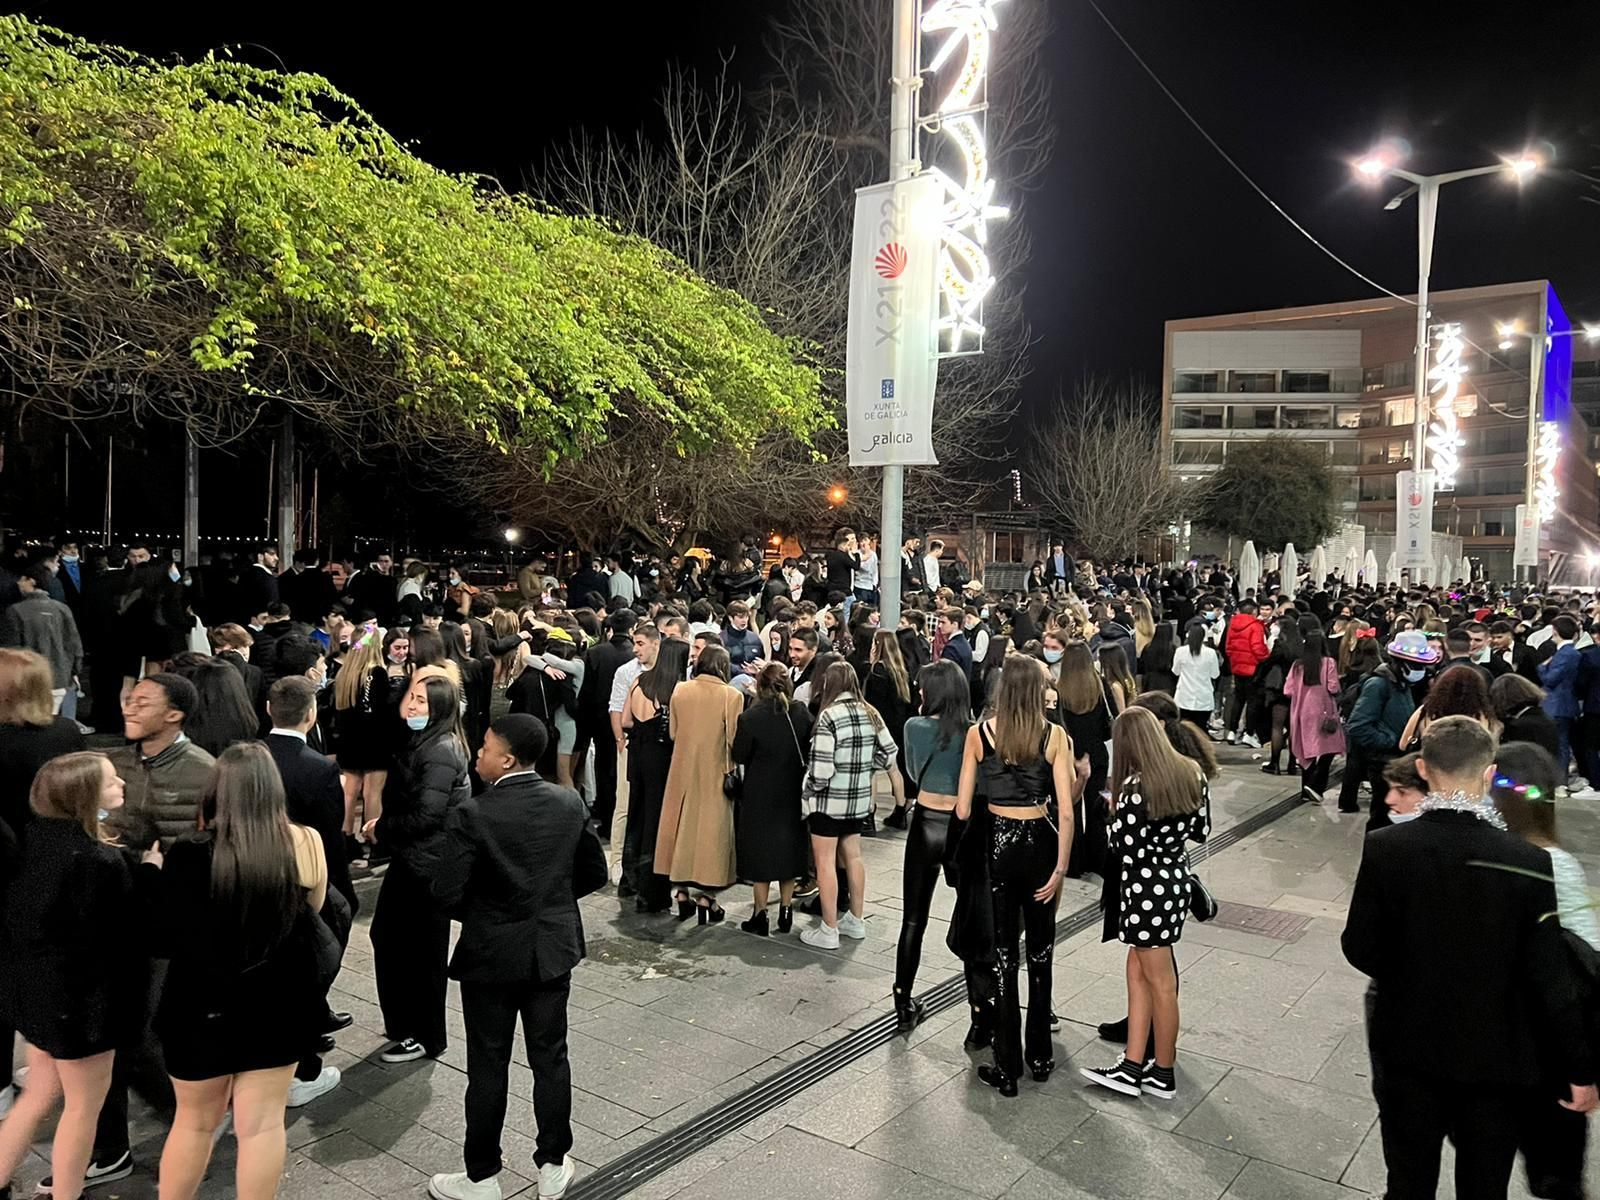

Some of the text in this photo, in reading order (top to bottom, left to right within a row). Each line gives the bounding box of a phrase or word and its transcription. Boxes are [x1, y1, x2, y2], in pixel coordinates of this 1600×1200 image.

[874, 284, 904, 348] X21
[873, 402, 900, 411] XUNTA
[864, 410, 908, 420] DE GALICIA
[861, 431, 913, 453] galicia
